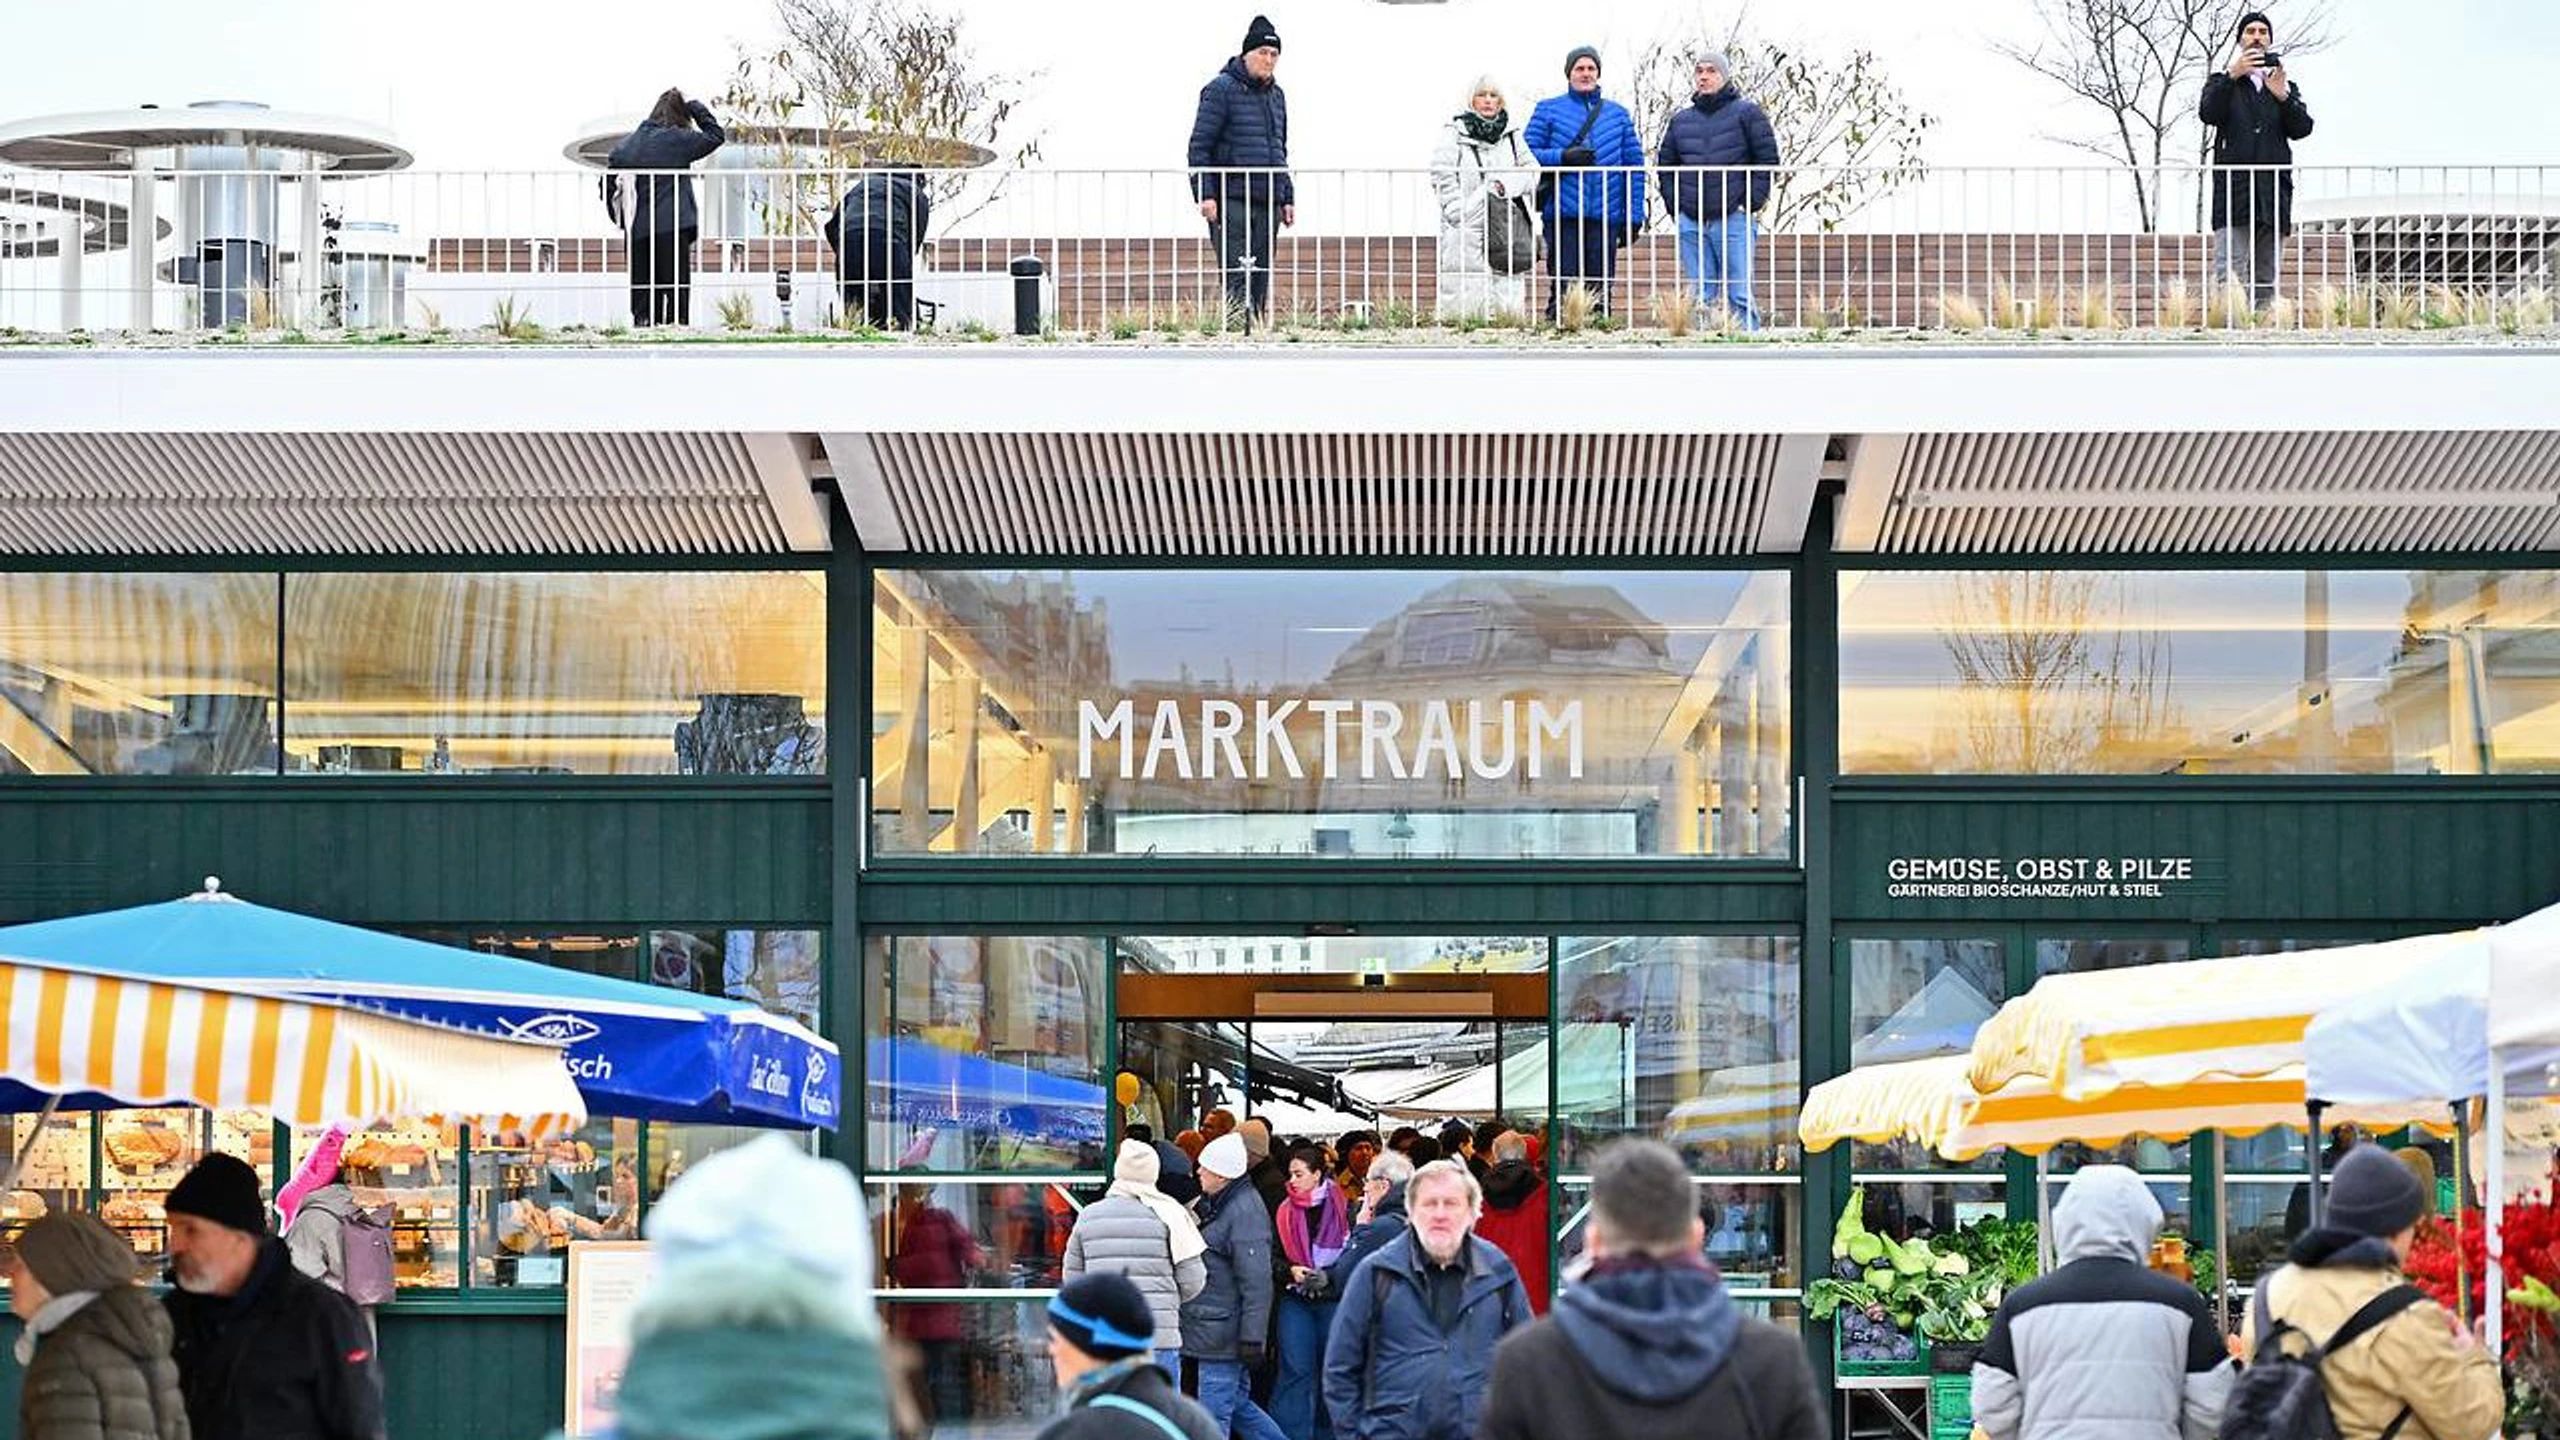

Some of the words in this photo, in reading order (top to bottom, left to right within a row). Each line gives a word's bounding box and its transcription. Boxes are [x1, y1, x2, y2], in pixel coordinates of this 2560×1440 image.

[1078, 700, 1584, 779] MARKTRAUM
[1888, 858, 2009, 883] GEMÜSE,
[2016, 859, 2089, 880] OBST
[2096, 859, 2113, 880] &
[2121, 859, 2192, 880] PILZE
[1888, 884, 1970, 897] GÄRTNEREI
[1973, 884, 2106, 898] BIOSCHANZE/HUT
[2110, 884, 2120, 897] &
[2123, 884, 2162, 897] STIEL
